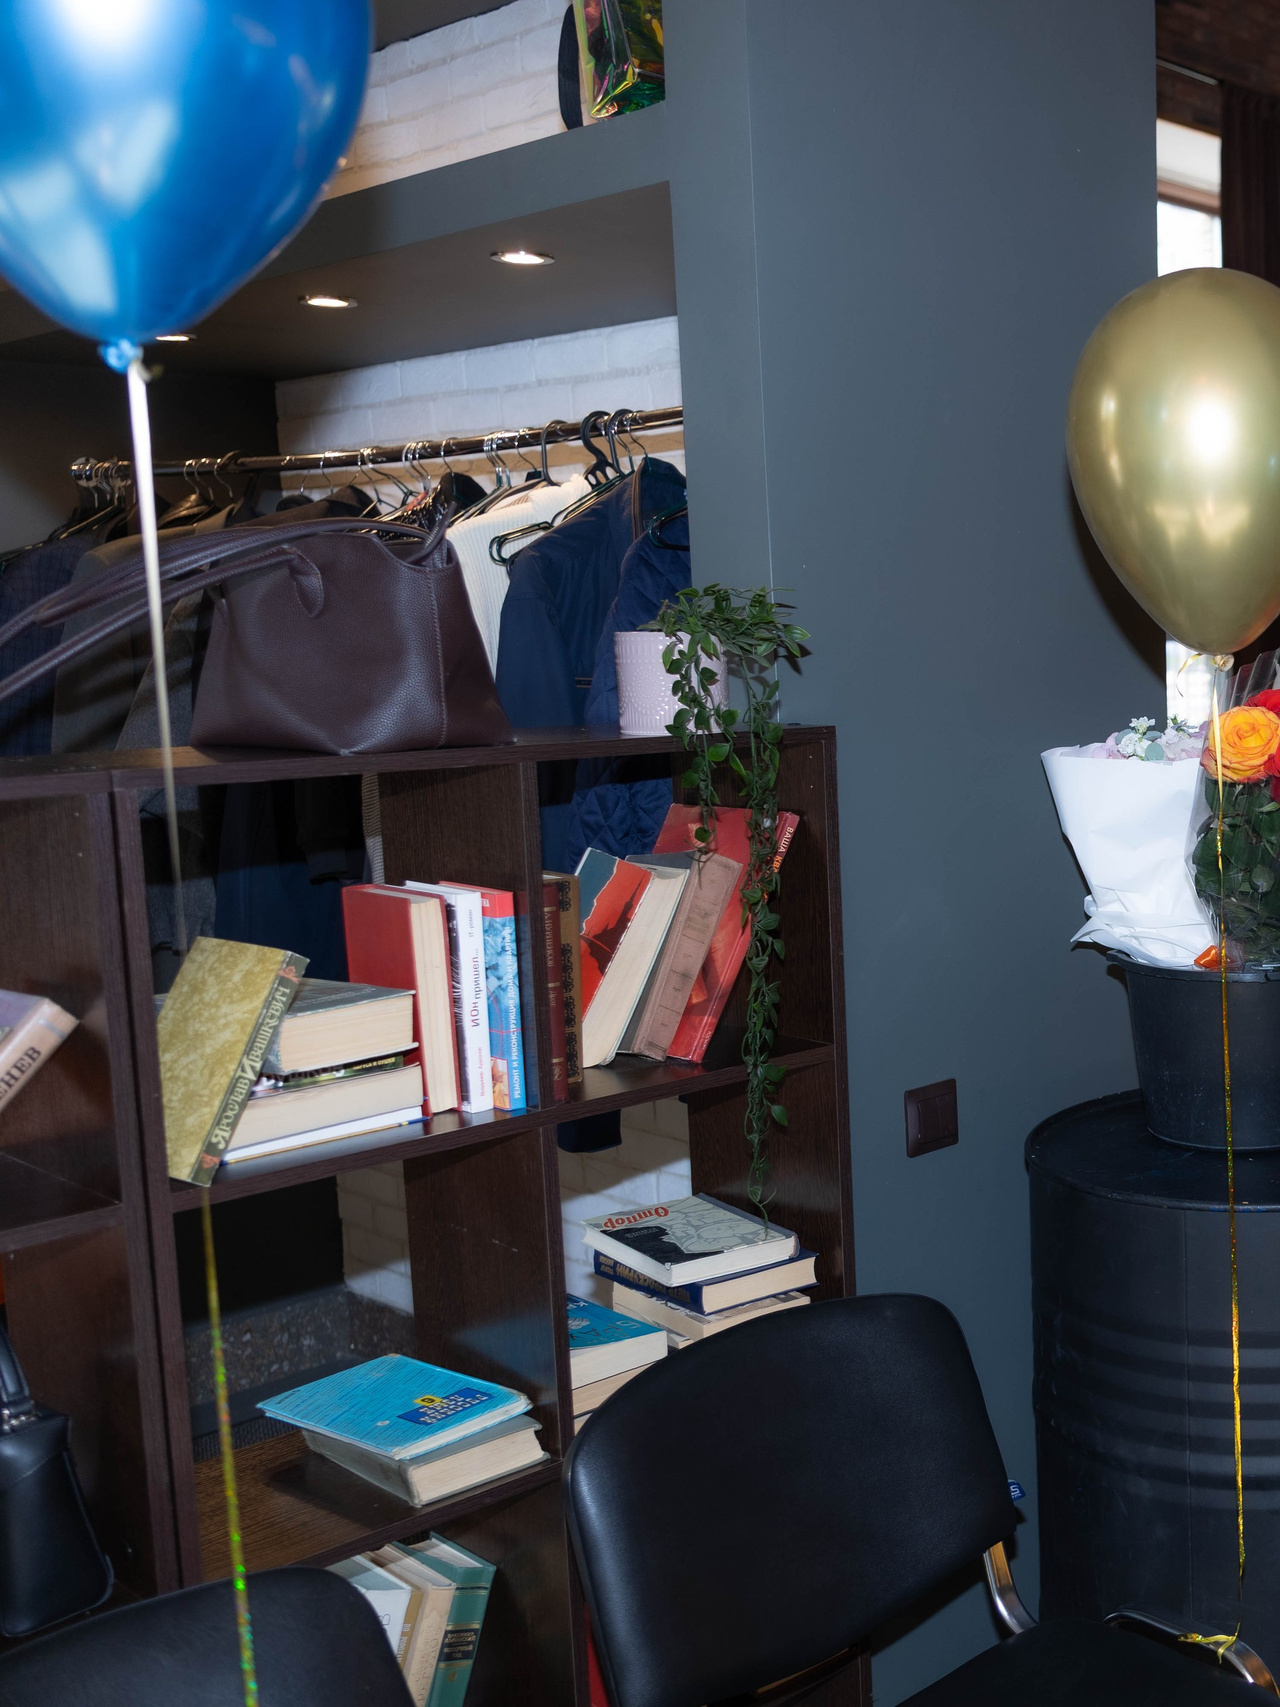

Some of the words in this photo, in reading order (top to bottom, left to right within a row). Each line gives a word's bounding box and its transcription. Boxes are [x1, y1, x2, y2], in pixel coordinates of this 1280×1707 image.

[779, 826, 794, 852] ВАША
[504, 926, 513, 965] КВАРТИРЫ
[507, 975, 516, 997] ДОМА
[470, 1001, 480, 1017] Он
[471, 1019, 480, 1027] И
[508, 1000, 519, 1059] РЕКОНСТРУКЦИЯ
[512, 1069, 521, 1098] РЕМОНТ
